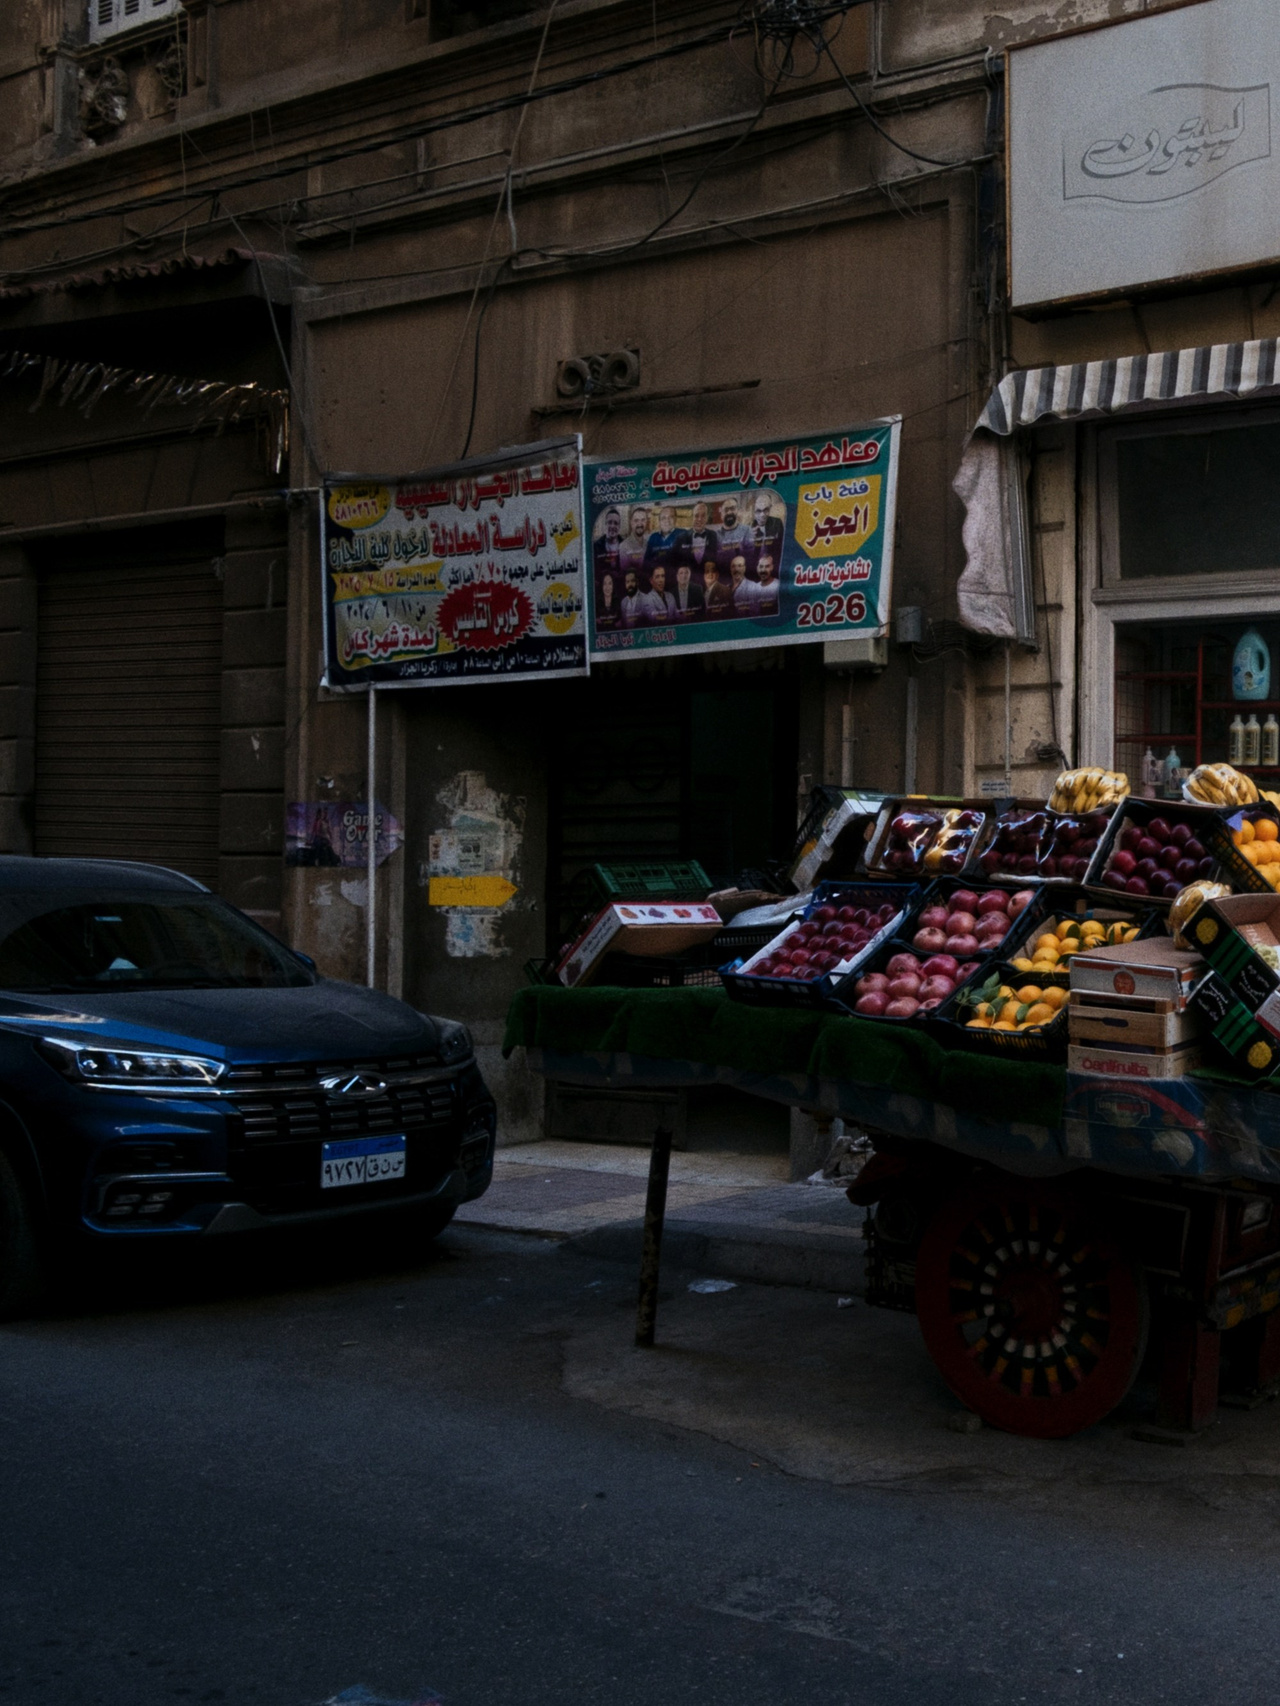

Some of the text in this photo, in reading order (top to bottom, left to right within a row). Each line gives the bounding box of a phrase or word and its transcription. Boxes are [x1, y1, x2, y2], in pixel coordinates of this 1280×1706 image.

[1080, 97, 1246, 180] ليبتون
[521, 462, 578, 496] معاهد
[652, 438, 880, 492] معاهد الجزار التعليمية
[456, 470, 519, 511] الجزار
[804, 481, 870, 504] فتح باب
[431, 518, 490, 558] المعادلة
[493, 515, 547, 556] دراسة
[806, 505, 869, 547] الحجز
[370, 534, 392, 566] كلية
[394, 527, 429, 562] لدخول
[503, 564, 529, 584] مجموع
[530, 562, 544, 582] على
[795, 558, 872, 590] للثانوية العامة
[797, 592, 866, 627] 2026
[373, 625, 401, 660] شهر
[402, 624, 437, 654] لمدة
[346, 825, 383, 844] Ovr
[325, 1160, 366, 1183] ٩٧٢٧
